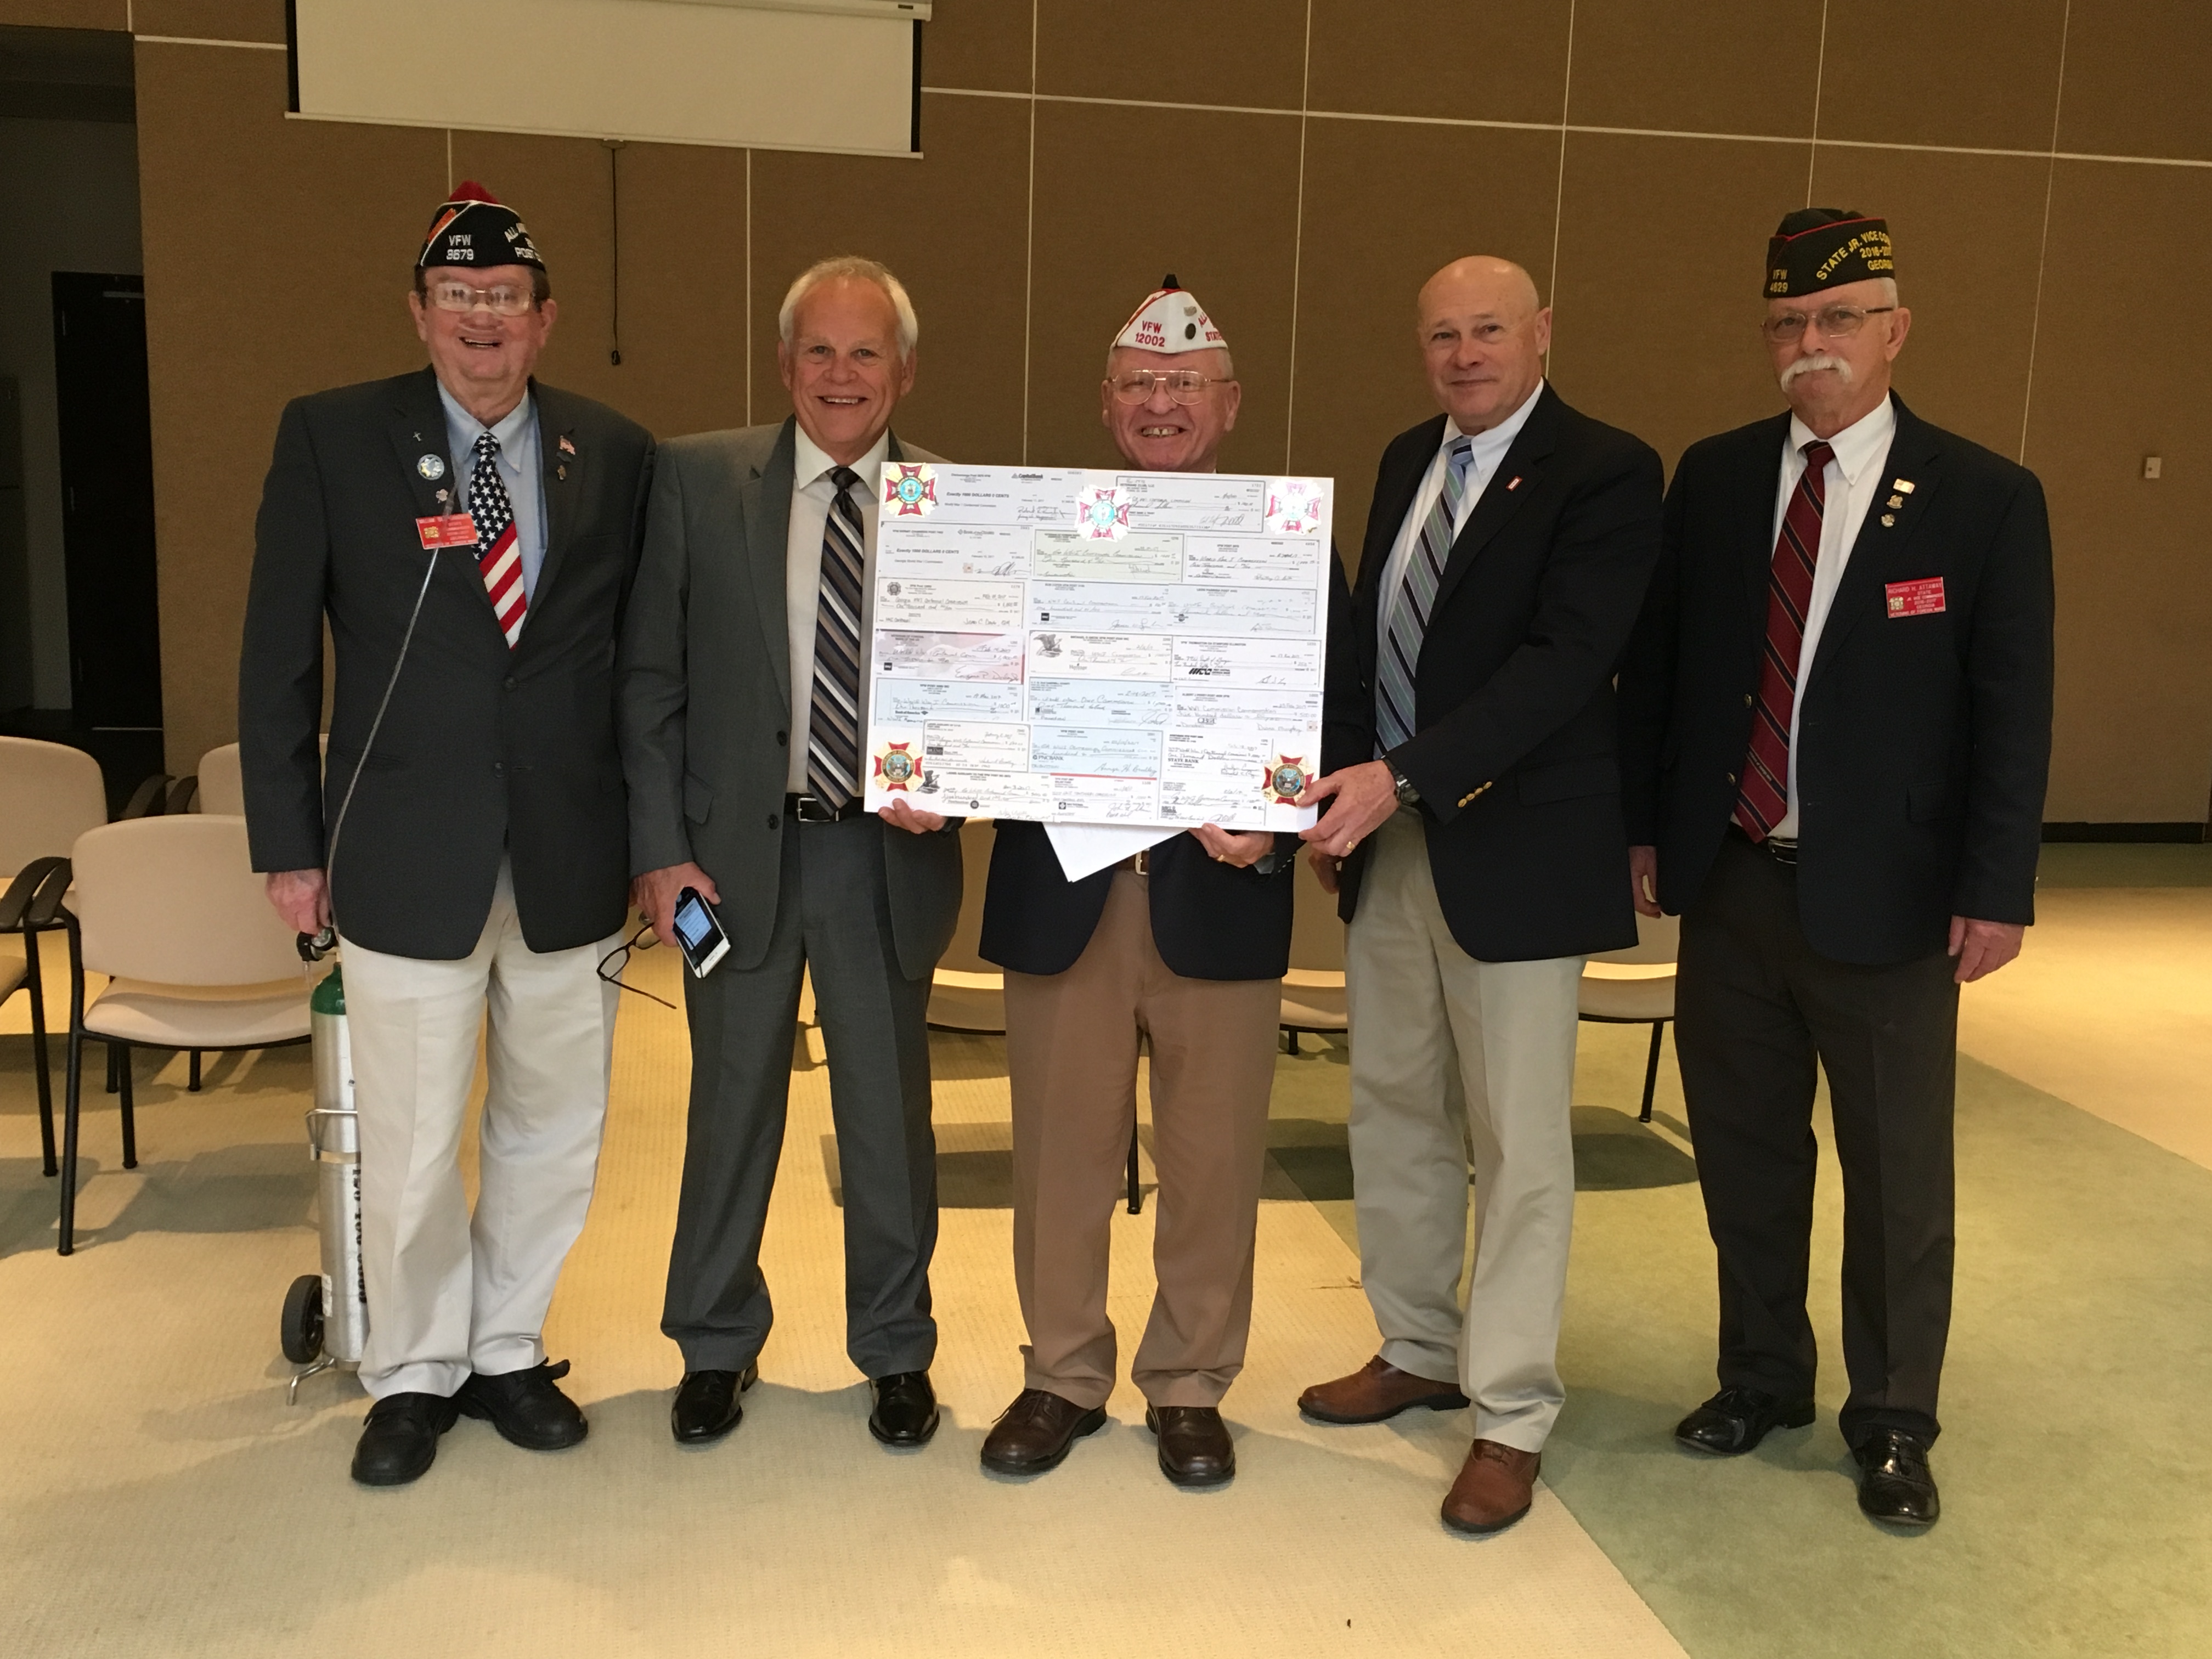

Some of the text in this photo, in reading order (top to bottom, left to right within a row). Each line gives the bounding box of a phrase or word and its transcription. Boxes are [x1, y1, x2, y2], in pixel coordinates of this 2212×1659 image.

[448, 234, 471, 246] VFW
[1816, 247, 1849, 280] STATE
[1848, 238, 1863, 252] JR.
[1860, 231, 1879, 243] VICE
[1773, 269, 1787, 280] VFW
[1142, 320, 1162, 334] VFW
[1135, 332, 1165, 347] 12002
[1919, 582, 1943, 590] ATTAWAY
